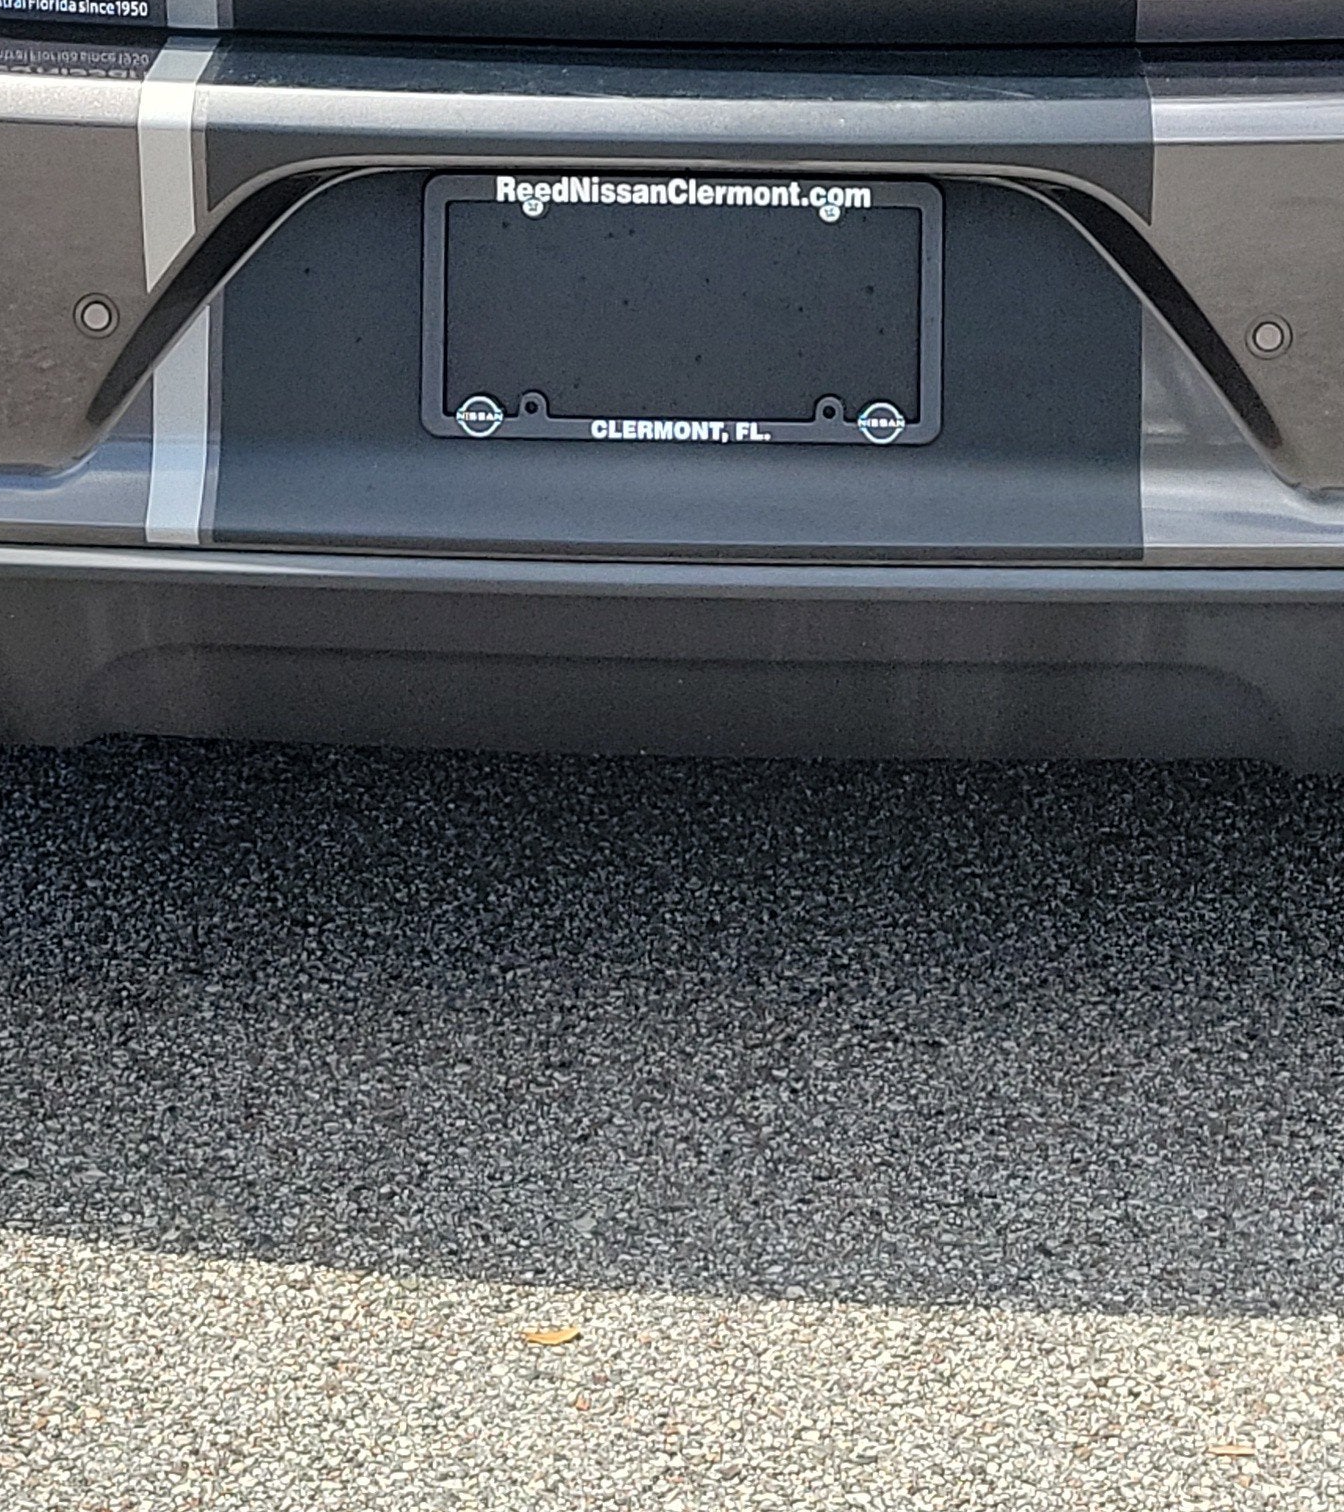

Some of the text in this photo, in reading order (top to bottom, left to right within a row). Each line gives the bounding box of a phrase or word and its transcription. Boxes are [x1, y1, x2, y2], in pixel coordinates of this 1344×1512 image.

[496, 176, 871, 208] ReedNissanClermont.com
[456, 411, 503, 422] NISSAN
[857, 417, 905, 428] NISSAN
[590, 419, 772, 443] CLERMONT, FL.
